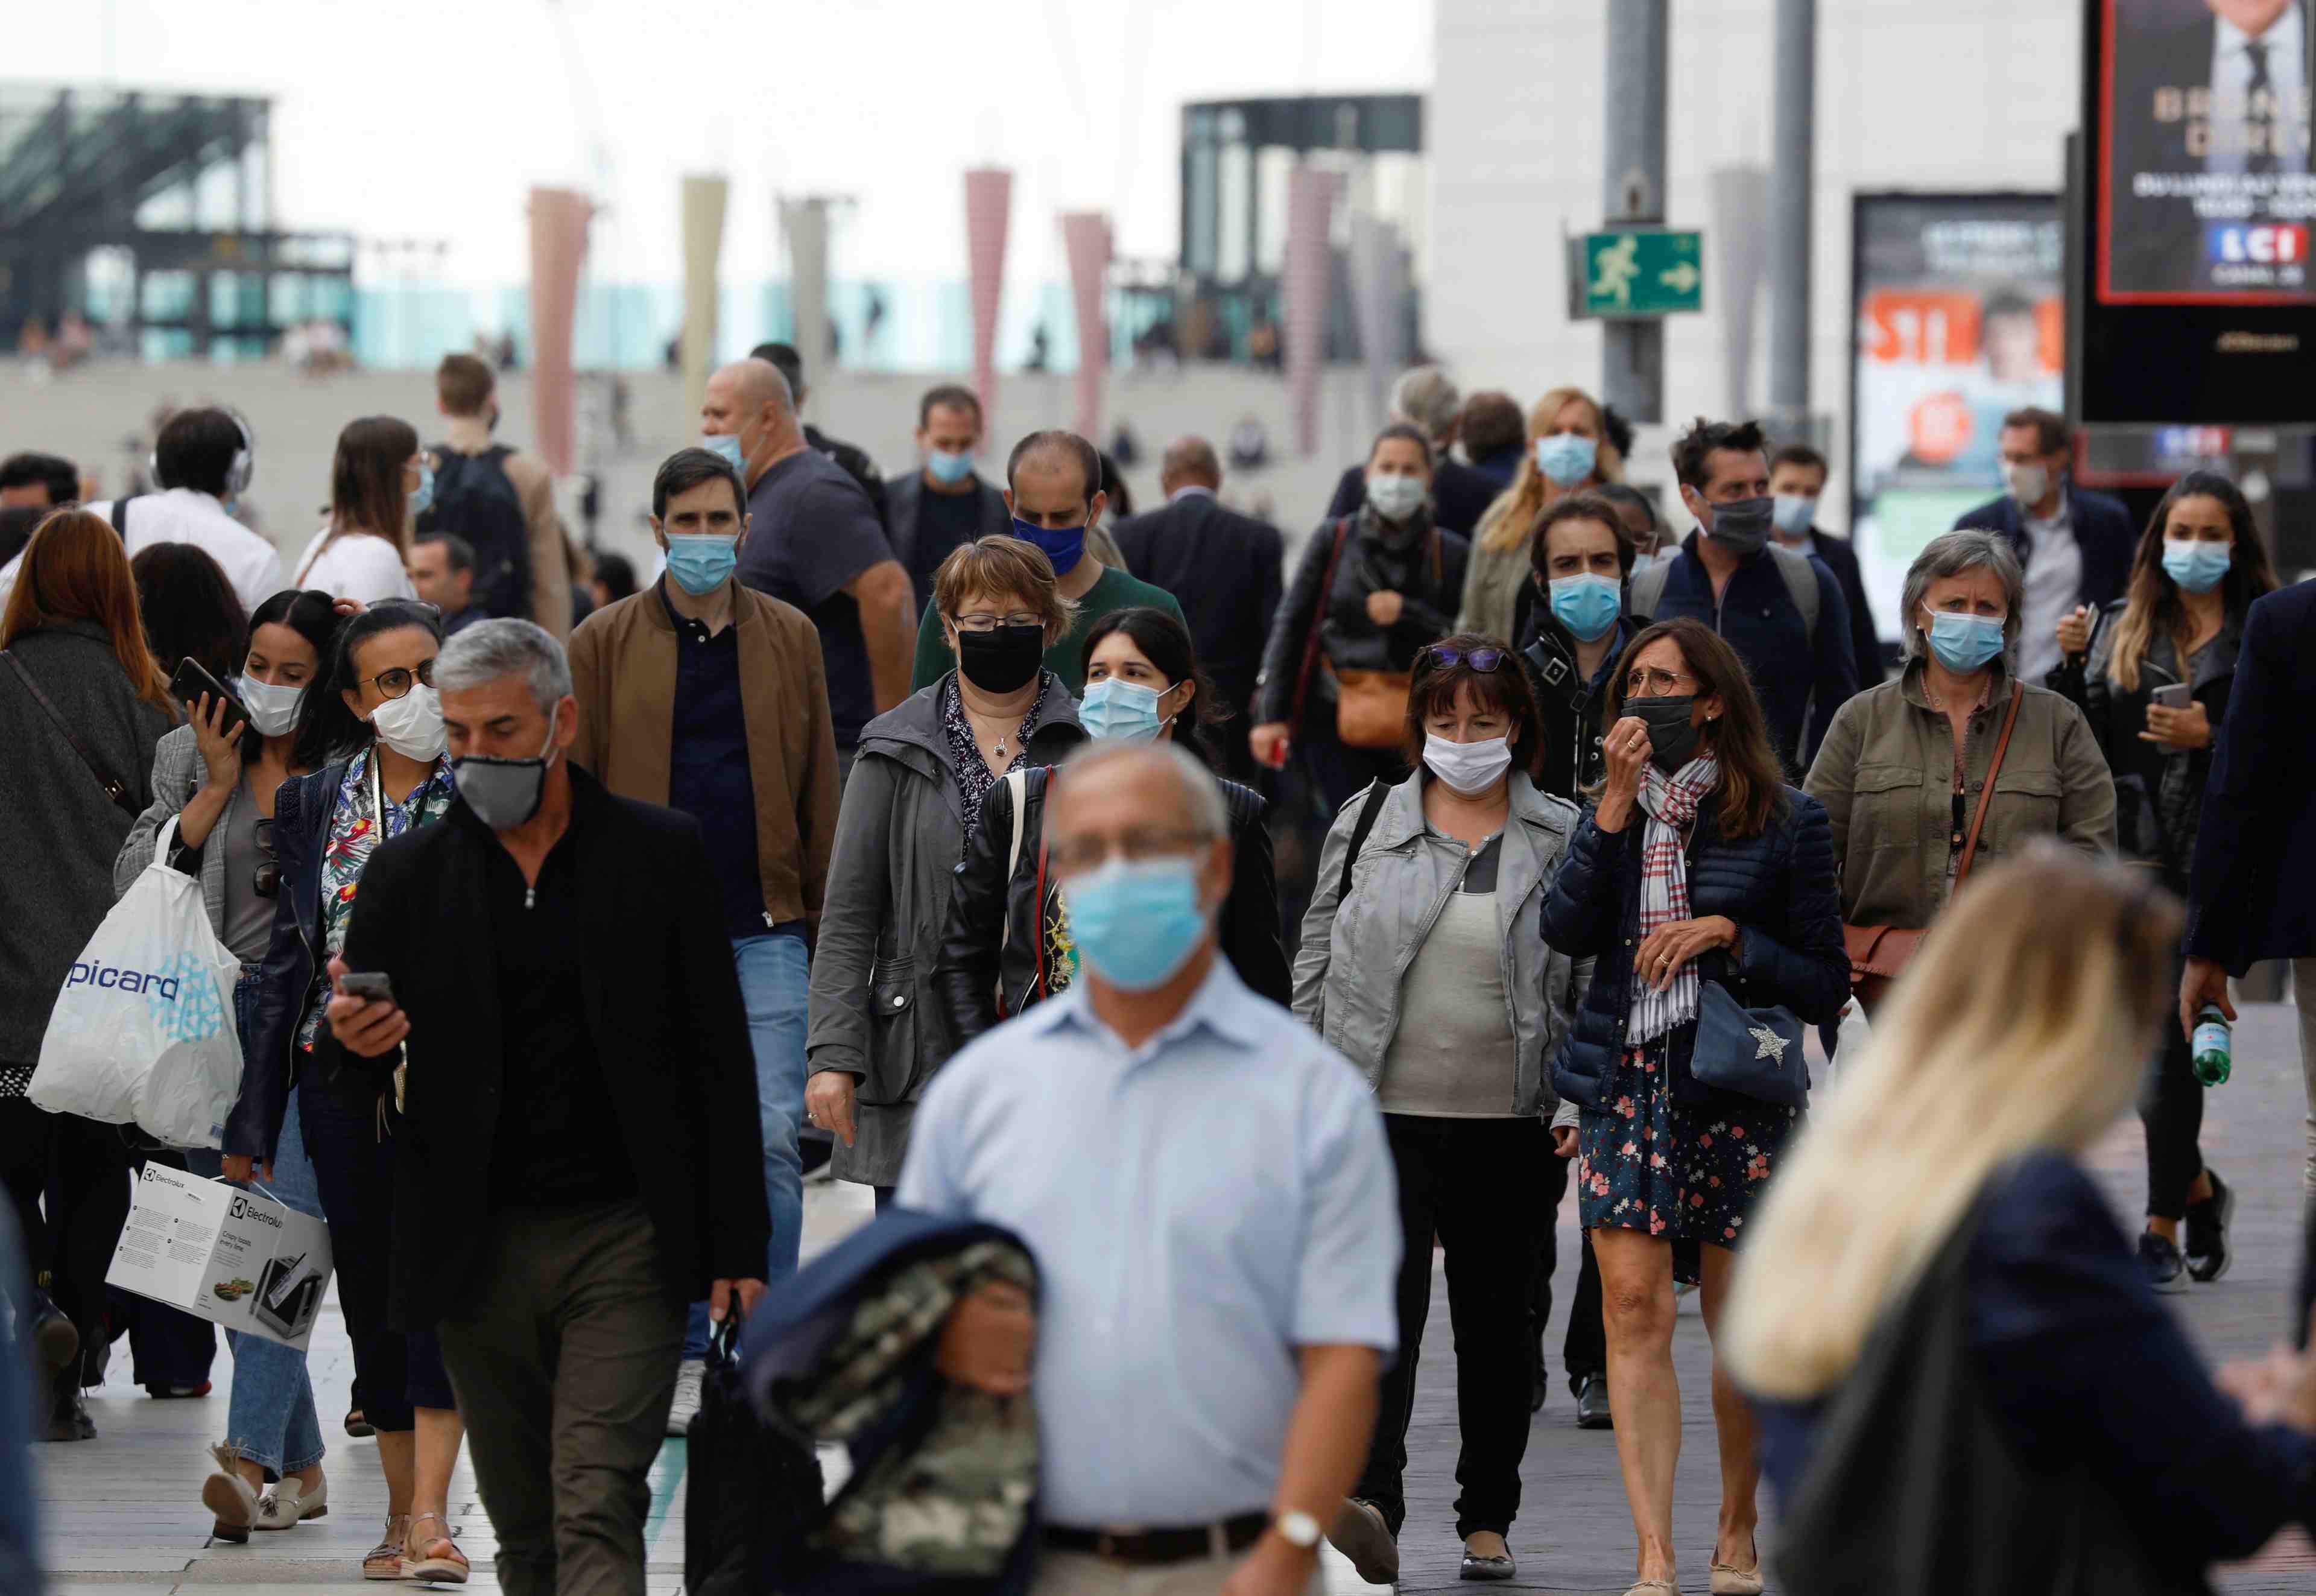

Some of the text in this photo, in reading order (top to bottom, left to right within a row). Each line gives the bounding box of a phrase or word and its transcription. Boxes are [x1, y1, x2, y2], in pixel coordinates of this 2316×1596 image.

[2222, 227, 2294, 262] LCI
[66, 960, 180, 1001] picard
[155, 1173, 185, 1188] Electrolux
